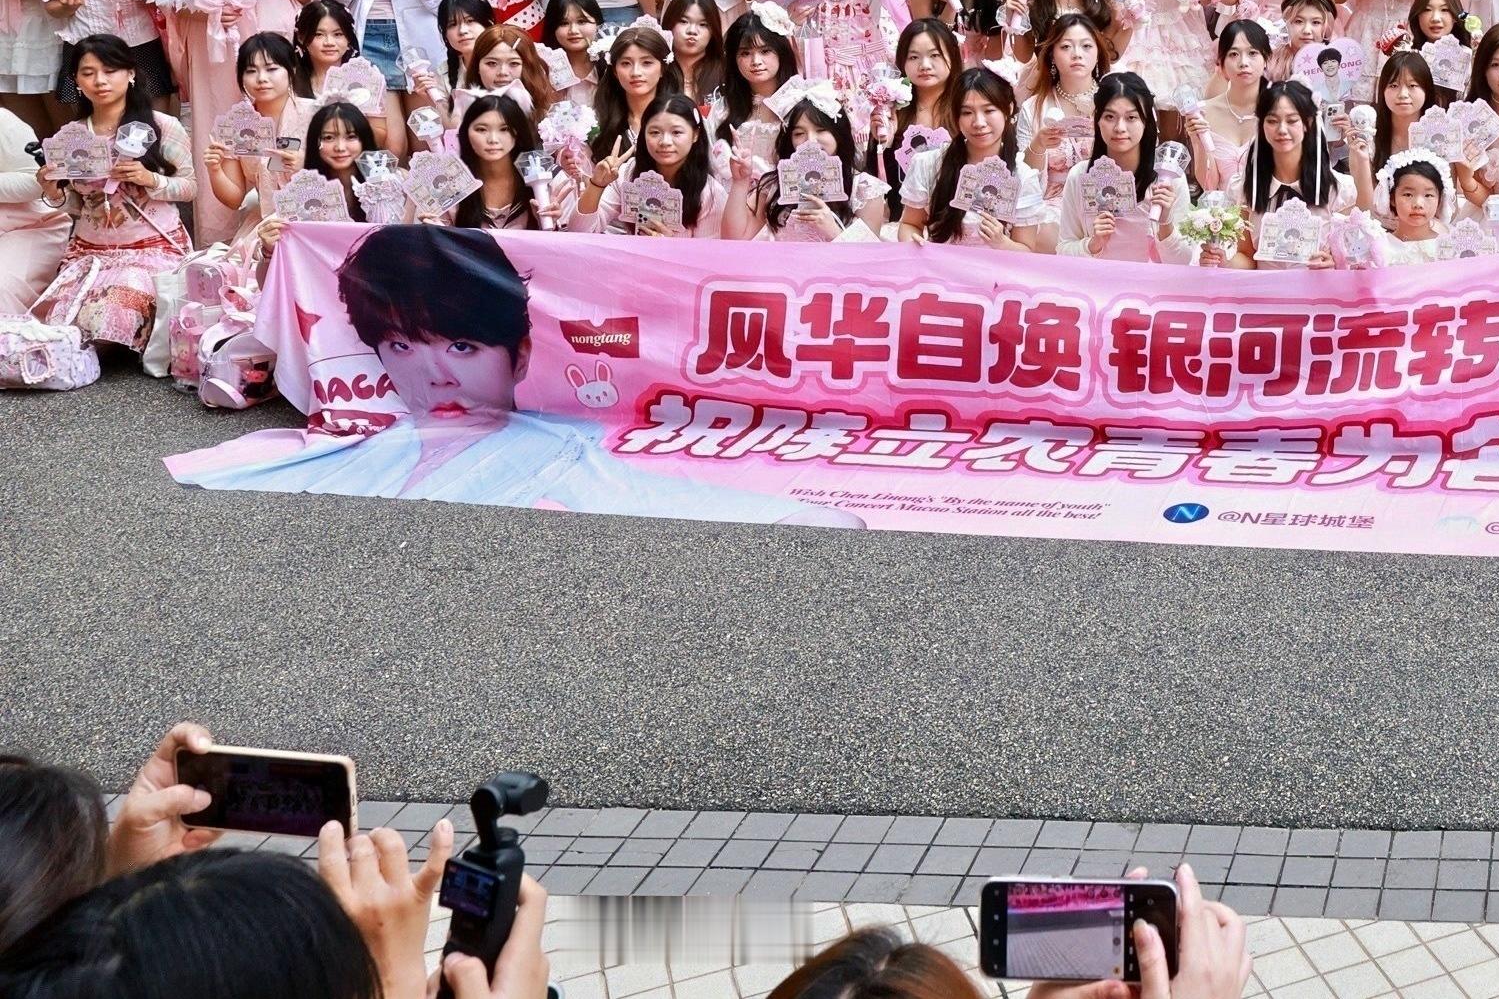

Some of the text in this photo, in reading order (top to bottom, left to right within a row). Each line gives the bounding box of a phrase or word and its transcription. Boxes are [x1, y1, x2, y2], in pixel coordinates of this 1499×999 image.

[571, 332, 632, 347] nongtang
[789, 488, 826, 497] Wish
[829, 490, 869, 499] Chen
[871, 492, 935, 504] Linong's
[966, 497, 992, 506] the
[994, 500, 1040, 508] name
[1041, 501, 1061, 509] of
[834, 499, 894, 510] Concert
[895, 503, 950, 513] Macao
[952, 506, 1008, 516] Station
[1010, 509, 1035, 517] all
[1036, 509, 1062, 518] the
[1063, 511, 1102, 520] best!
[1217, 510, 1375, 529] @N星球城堡
